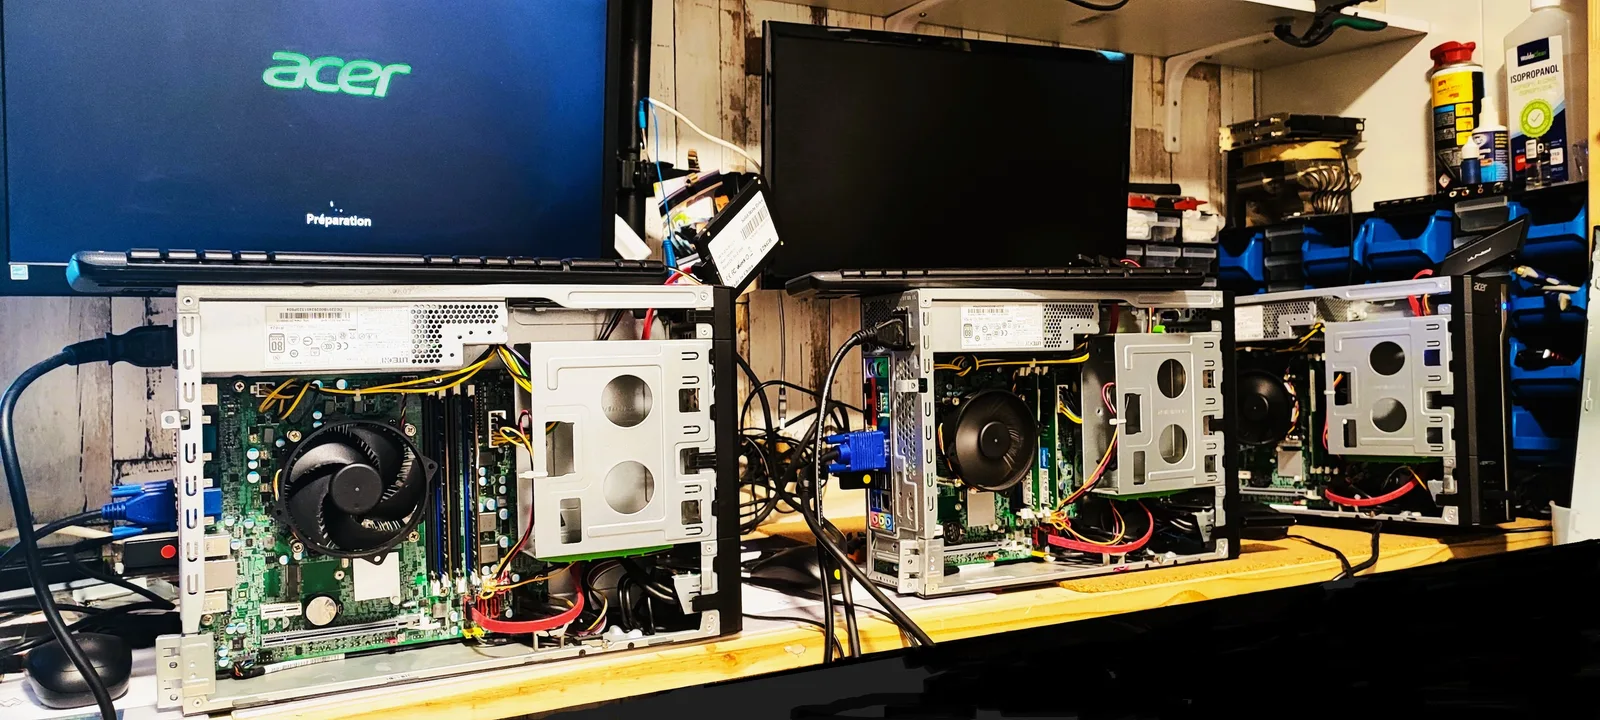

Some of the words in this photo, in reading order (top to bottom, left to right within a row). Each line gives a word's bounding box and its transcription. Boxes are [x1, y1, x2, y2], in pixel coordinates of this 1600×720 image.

[262, 51, 411, 98] acer
[1510, 64, 1559, 83] ISOPROPANOL
[306, 213, 372, 228] Préparation
[1473, 282, 1488, 291] acer
